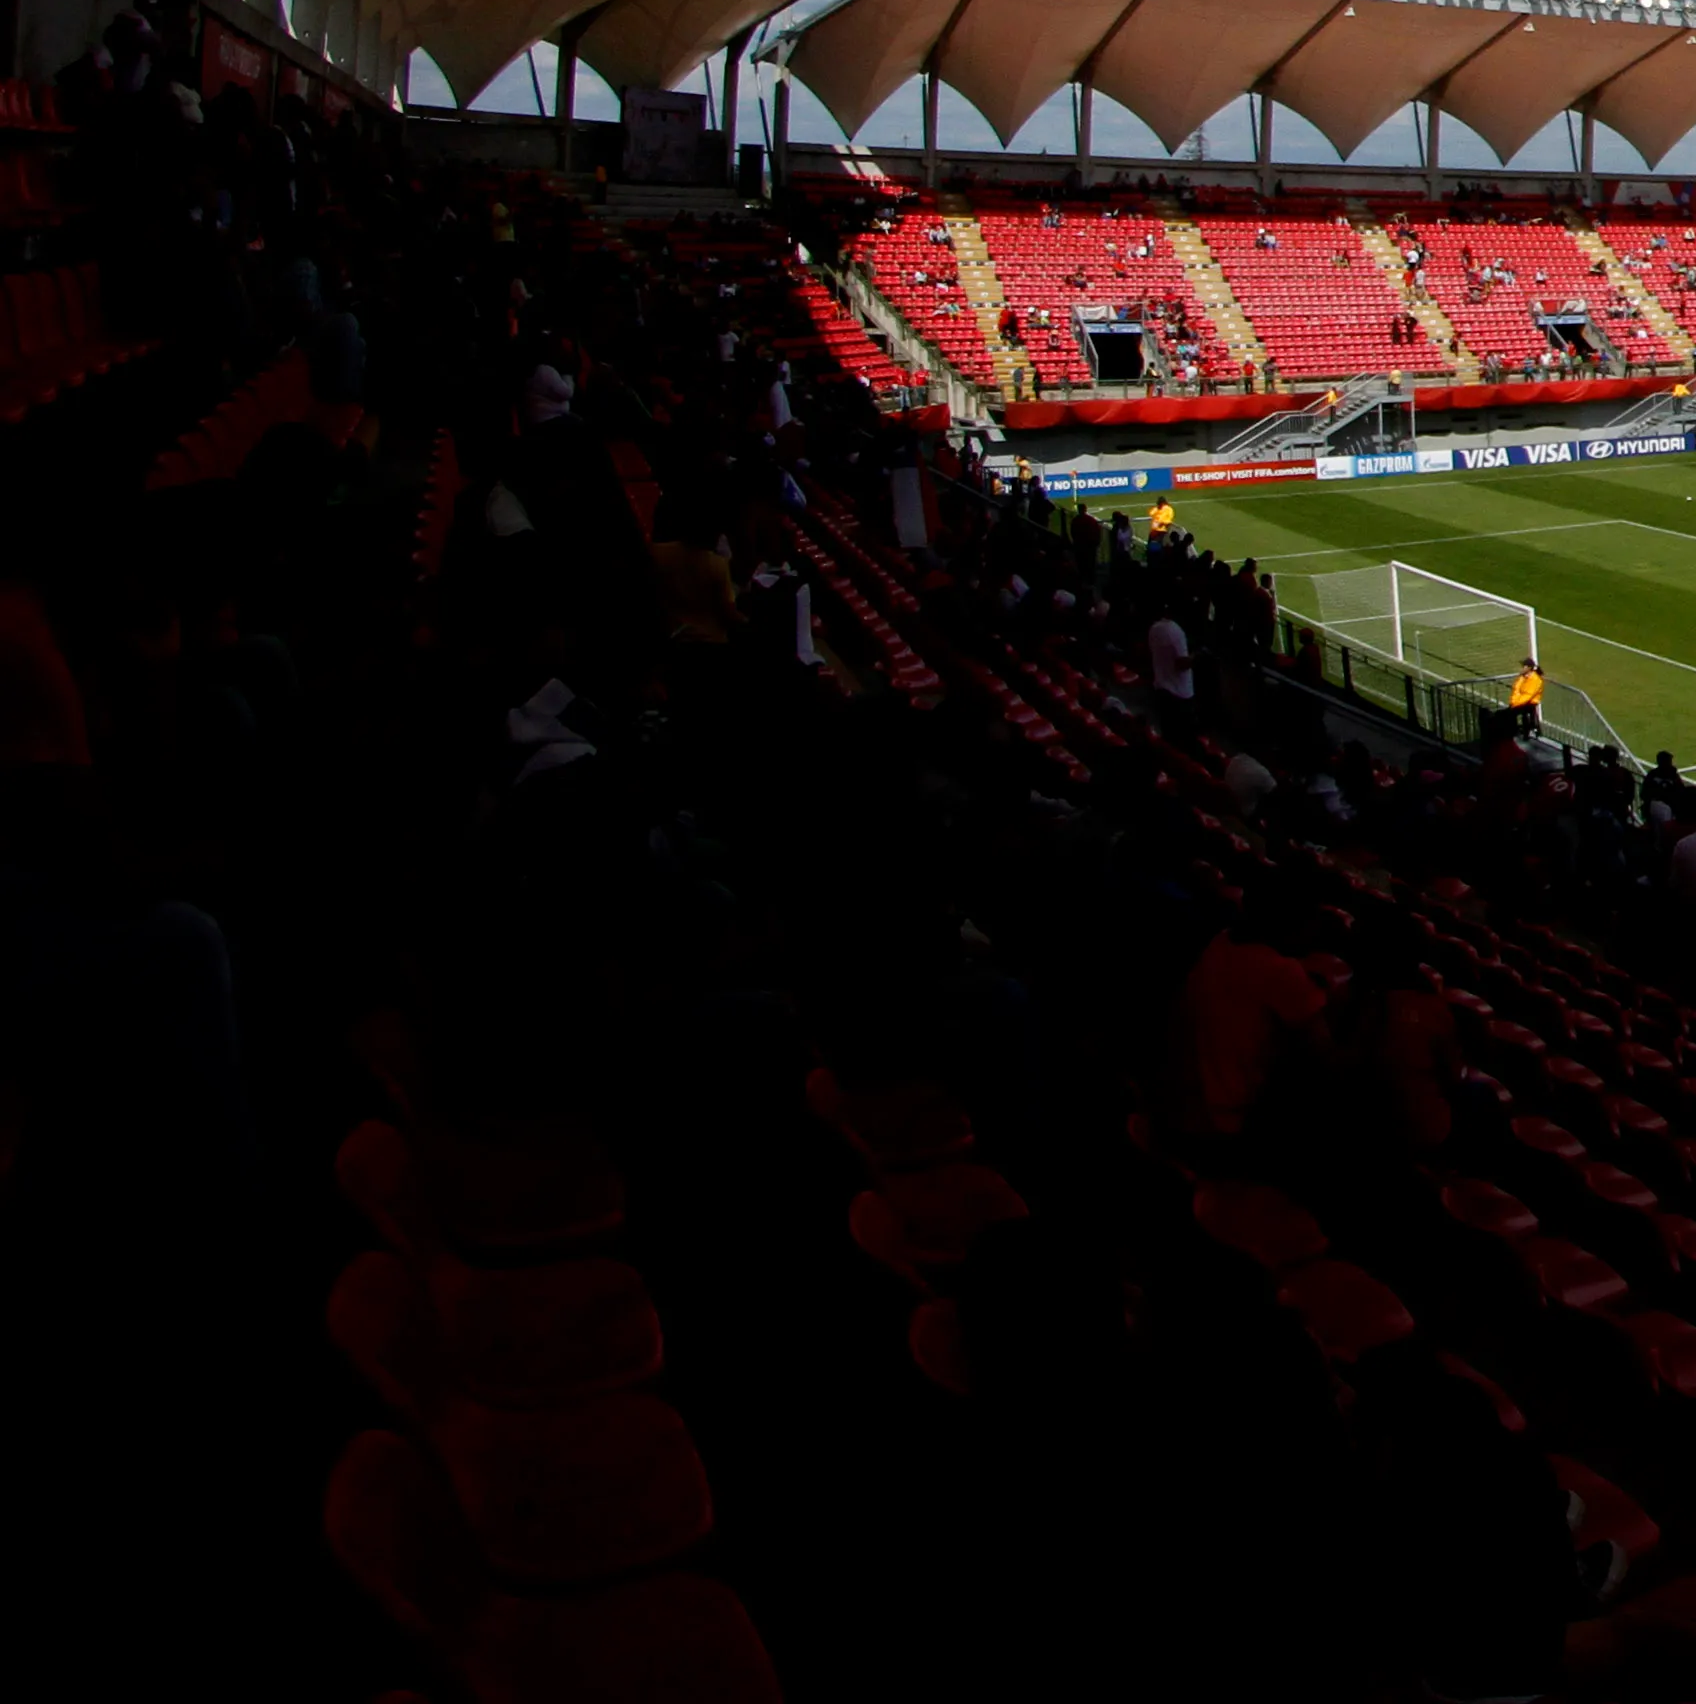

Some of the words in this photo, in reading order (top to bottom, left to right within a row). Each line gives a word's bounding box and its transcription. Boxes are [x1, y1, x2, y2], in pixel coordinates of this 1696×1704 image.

[1522, 442, 1572, 464] VISA
[1616, 437, 1685, 455] HYUNDAI
[1357, 455, 1413, 475] GAZPROM
[1460, 447, 1510, 469] VISA
[1054, 478, 1070, 490] NO
[1072, 477, 1086, 489] TO
[1088, 476, 1129, 488] RACISM
[1176, 473, 1193, 483] THE
[1195, 471, 1226, 482] E-SHOP
[1232, 468, 1253, 480] VISIT
[1255, 466, 1316, 478] FIFA.com/store
[1548, 777, 1569, 793] 10
